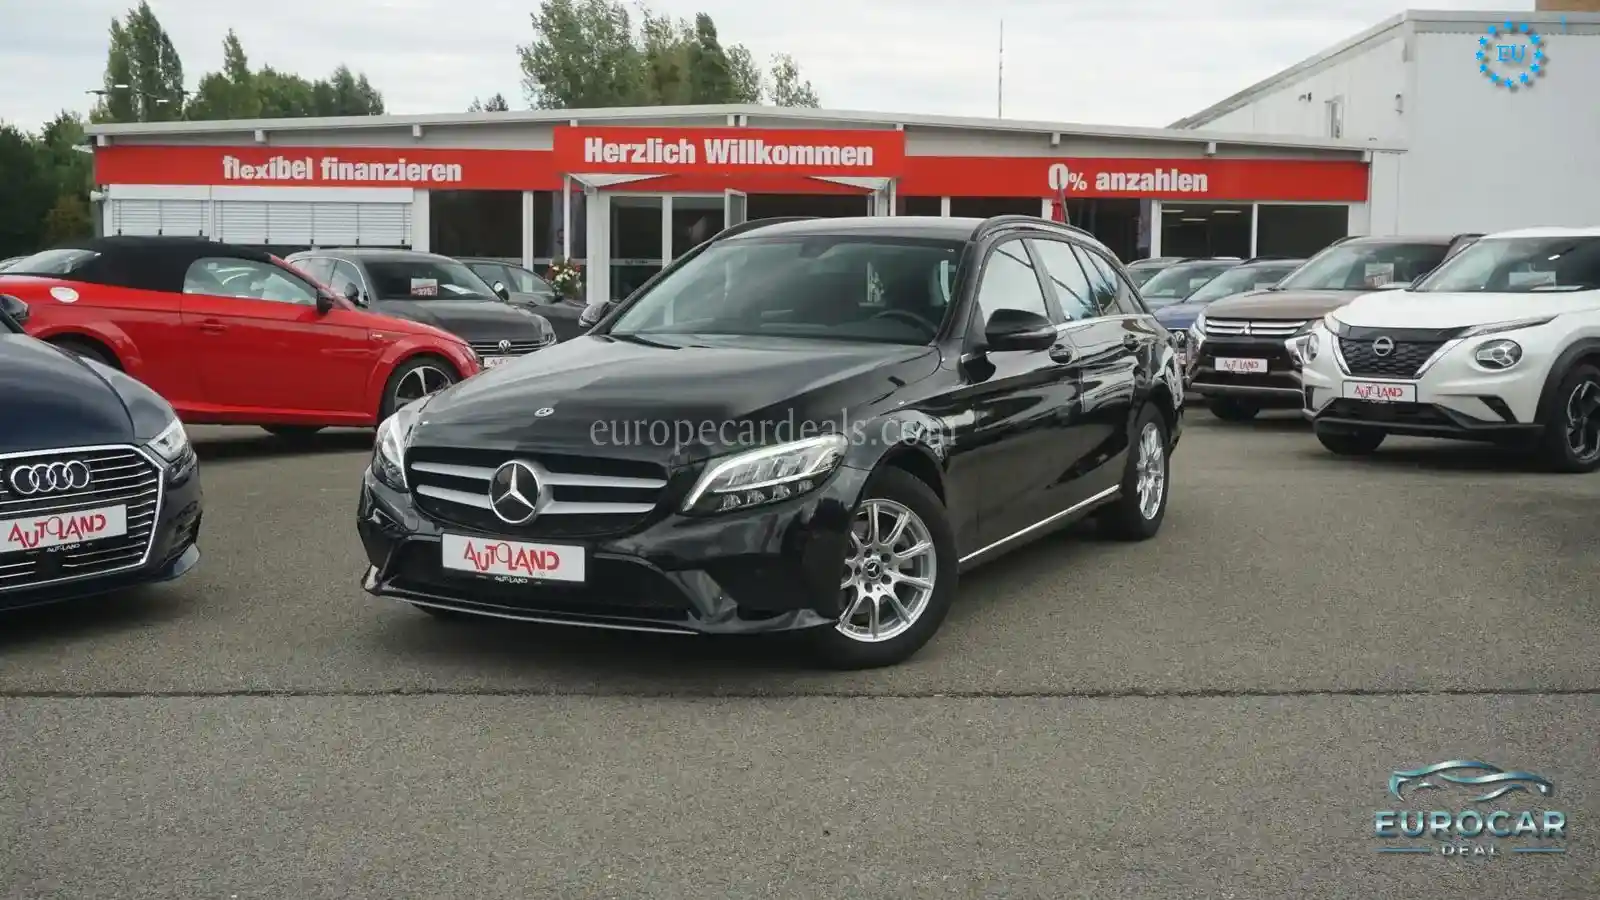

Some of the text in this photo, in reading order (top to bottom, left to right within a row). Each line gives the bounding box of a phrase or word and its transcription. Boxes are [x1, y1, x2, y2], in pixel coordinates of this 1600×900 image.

[585, 137, 873, 166] Herzlich Willkommen
[223, 155, 462, 181] flexibel finanzieren
[1048, 163, 1208, 192] 0% anzahlen
[1223, 360, 1259, 371] AUTLAND
[1354, 384, 1403, 400] AUTOLAND
[8, 513, 107, 549] AUTOLAND
[464, 540, 560, 576] AUTOLAND
